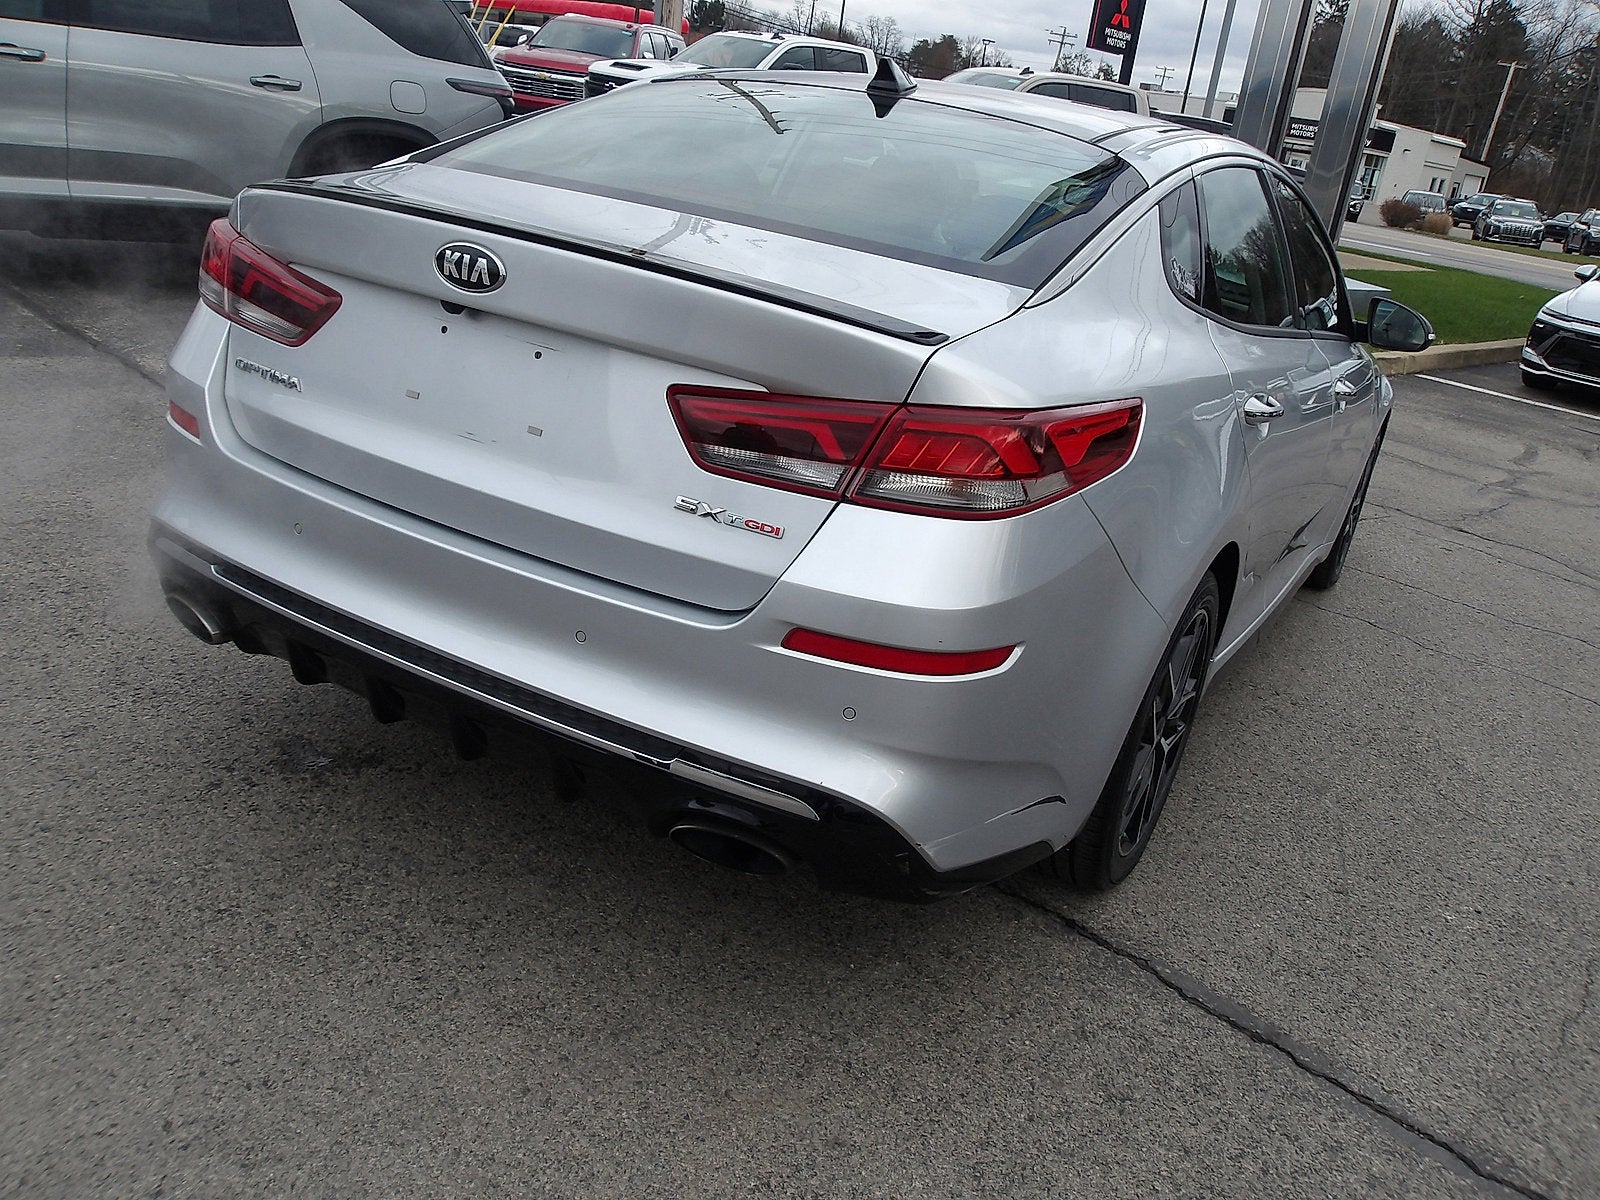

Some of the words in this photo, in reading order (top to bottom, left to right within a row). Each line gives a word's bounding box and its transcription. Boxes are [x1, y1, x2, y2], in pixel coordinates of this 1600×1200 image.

[1104, 27, 1131, 41] MITSUBISHI
[1106, 37, 1126, 49] MOTORS
[1290, 130, 1315, 138] MOTORS
[1291, 123, 1318, 132] MITSUBIS
[443, 249, 490, 285] KIA
[234, 356, 303, 392] OPTIMA
